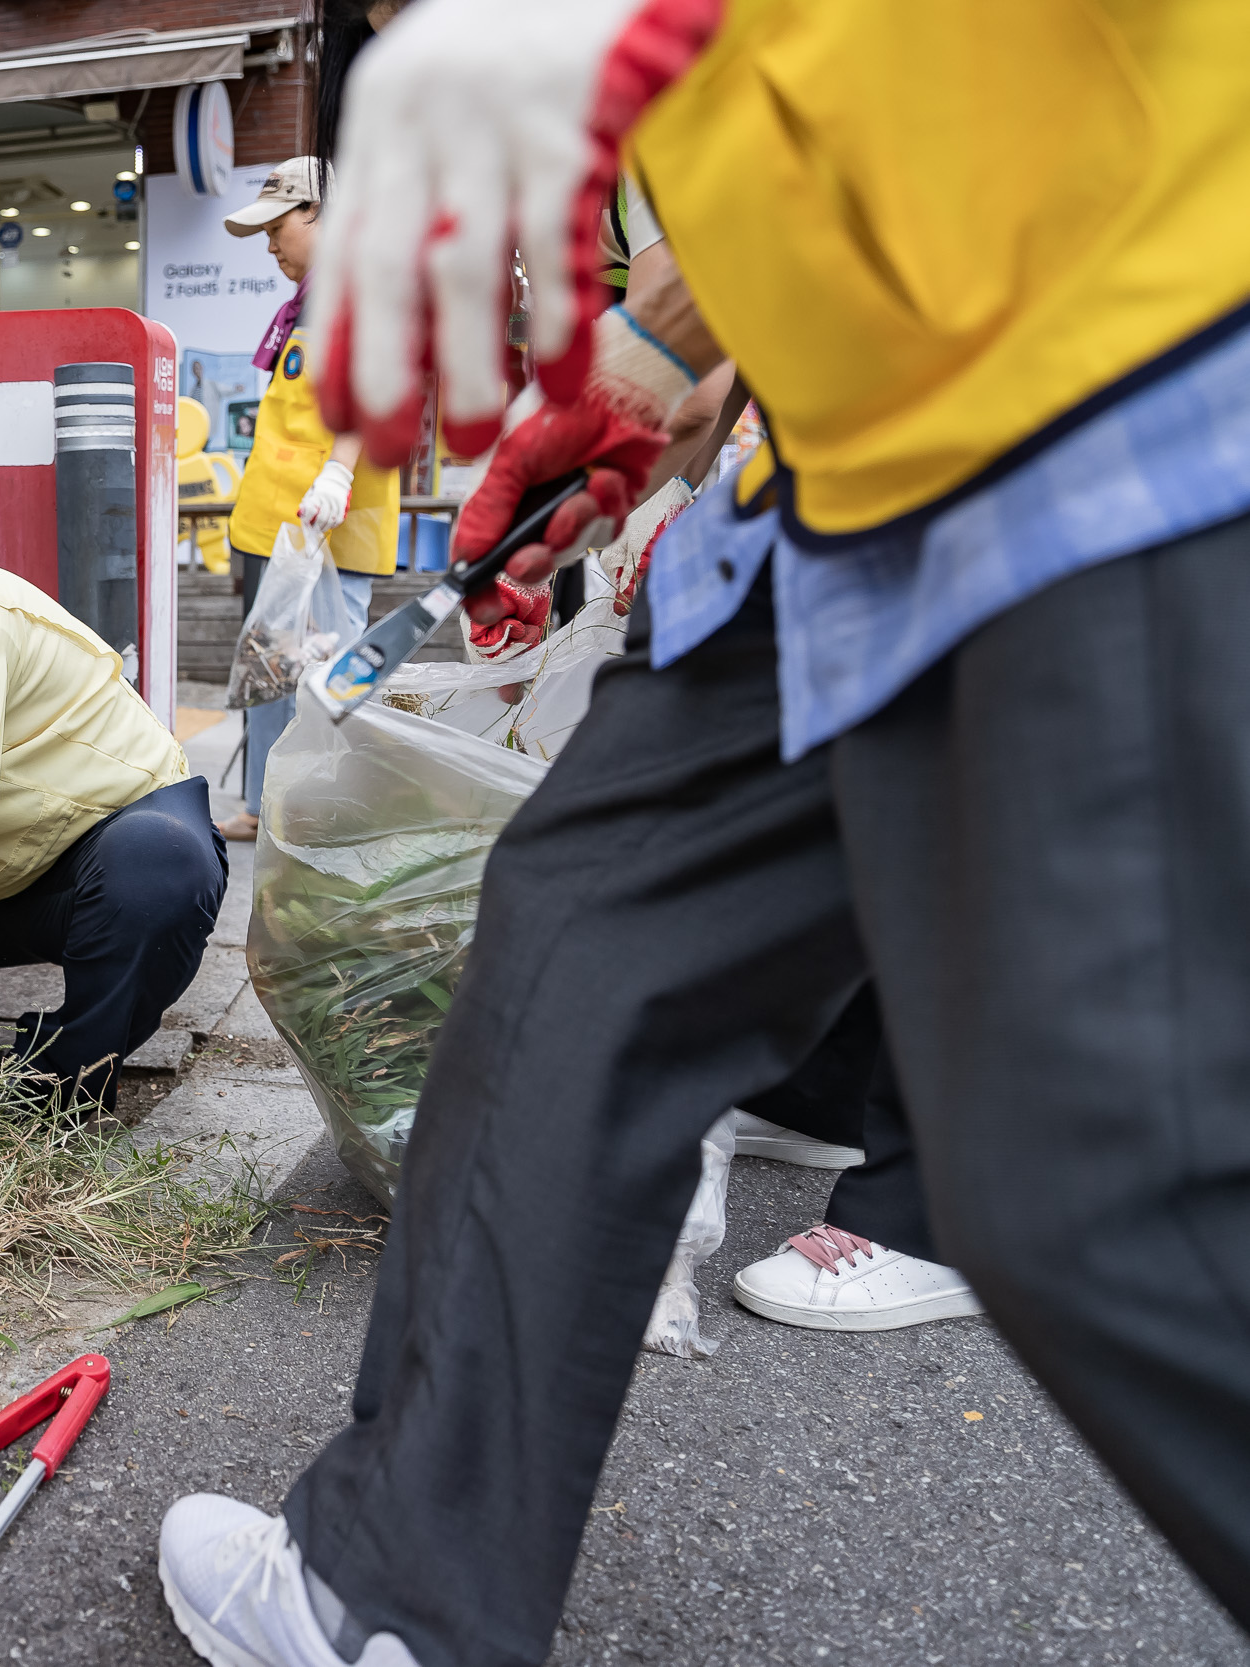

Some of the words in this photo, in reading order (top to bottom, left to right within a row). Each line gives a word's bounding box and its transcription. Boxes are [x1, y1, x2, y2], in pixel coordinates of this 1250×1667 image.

[162, 263, 223, 280] Galaxy
[164, 283, 174, 299] Z
[176, 281, 219, 298] Fold5
[228, 279, 237, 295] Z
[240, 276, 277, 297] Flip5
[153, 356, 174, 392] 사용법
